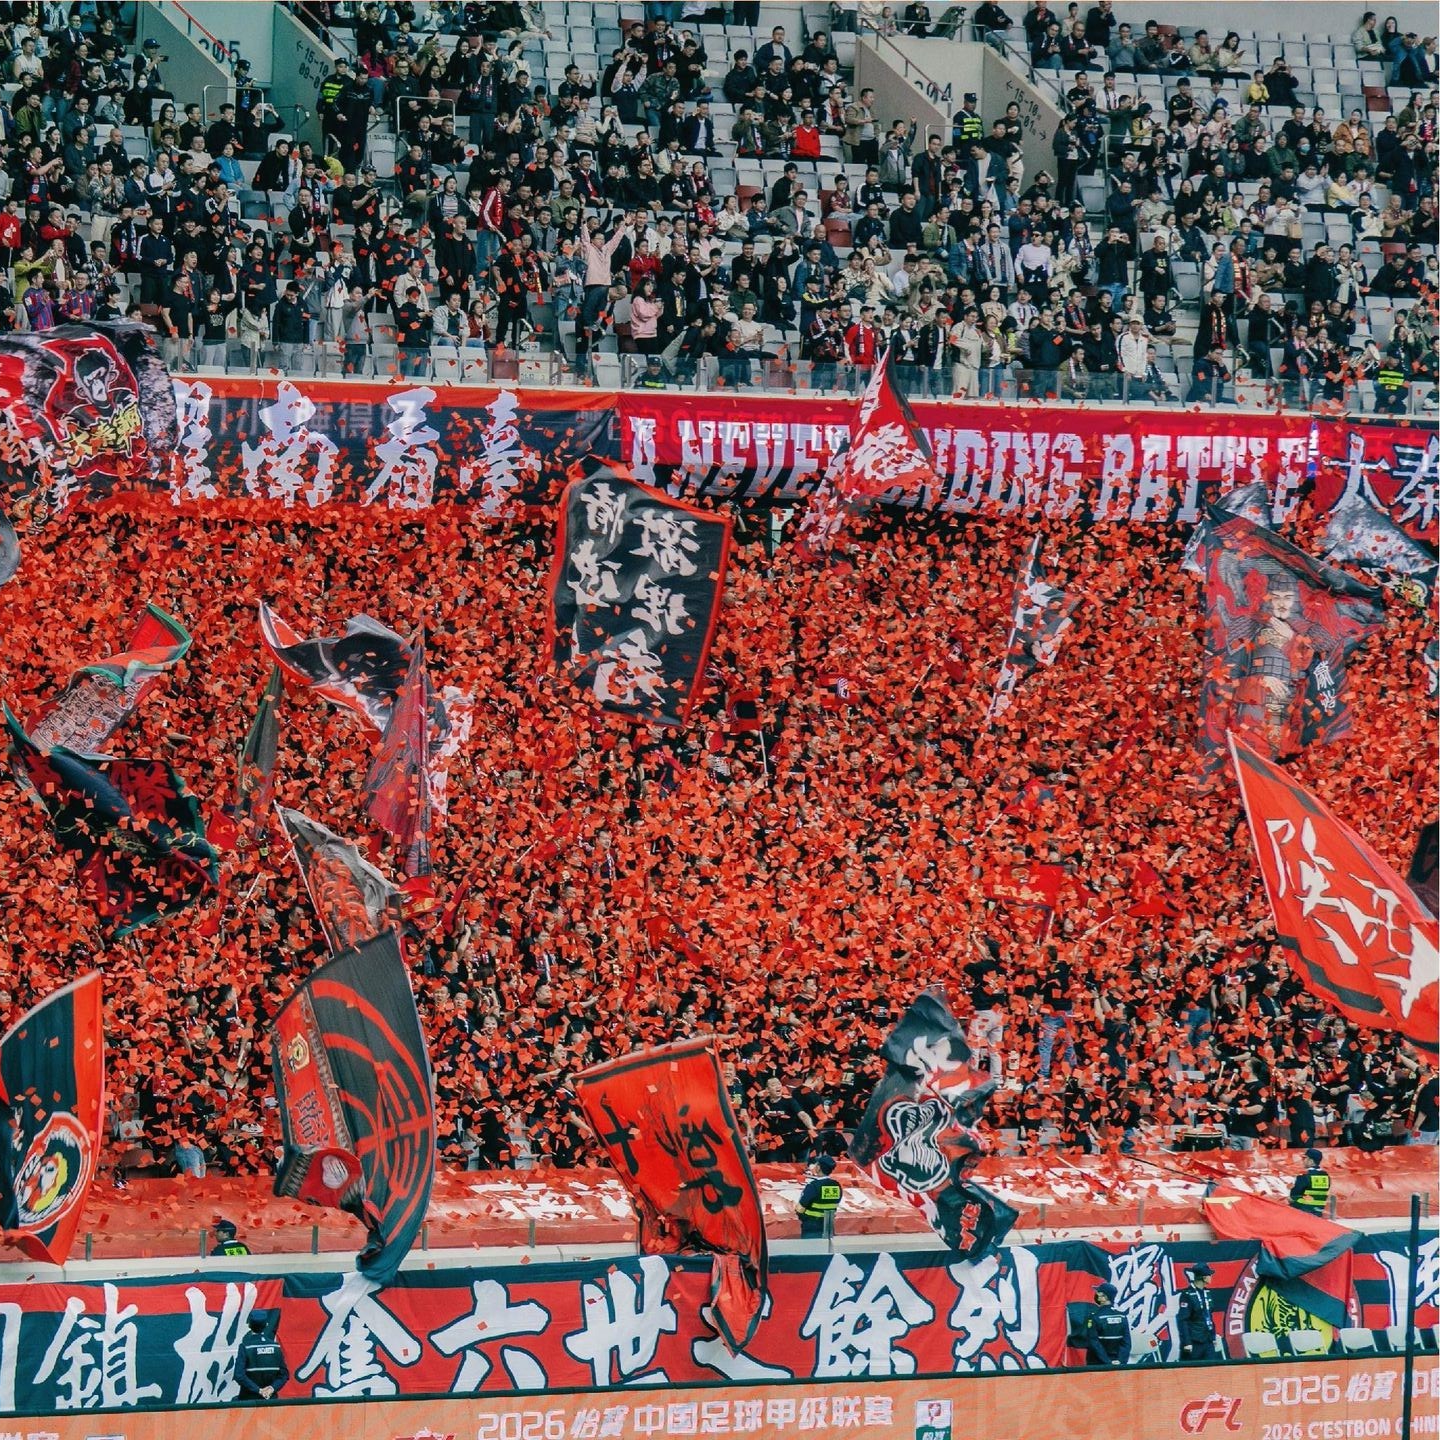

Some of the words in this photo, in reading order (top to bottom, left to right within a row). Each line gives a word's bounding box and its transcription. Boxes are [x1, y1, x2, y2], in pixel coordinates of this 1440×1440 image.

[676, 418, 854, 500] NEVE
[1261, 1375, 1341, 1407] 2026
[477, 1409, 565, 1440] 2026
[633, 1396, 894, 1435] 中国足球甲级联赛
